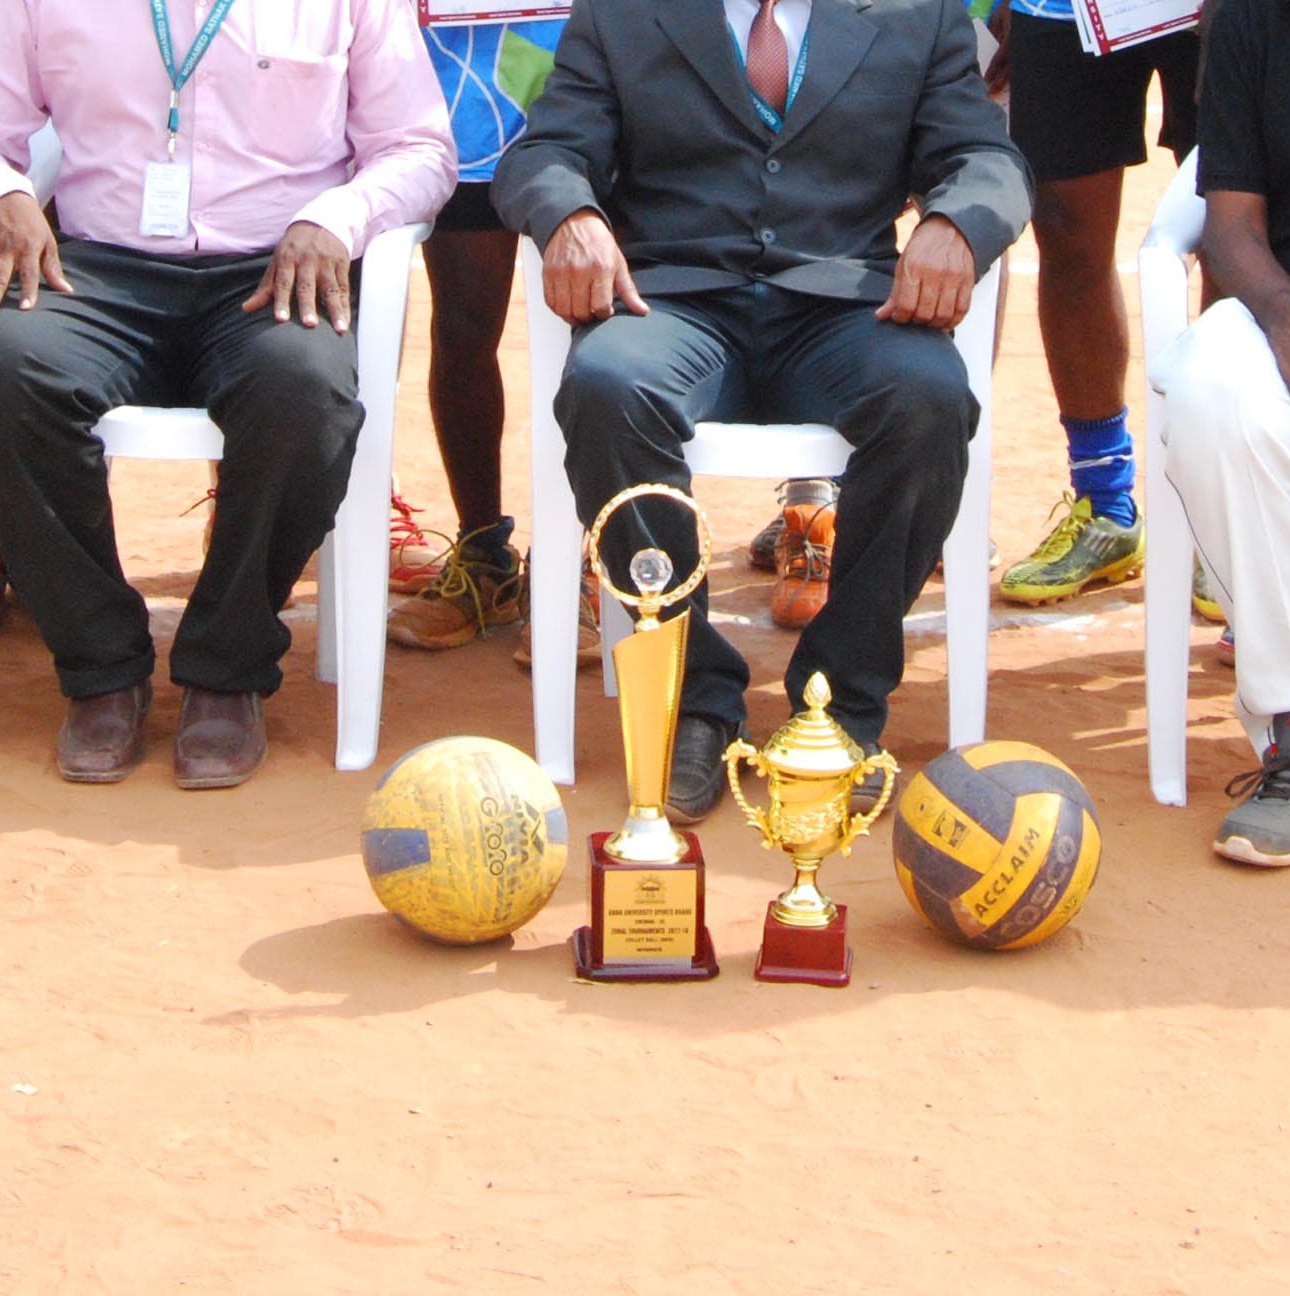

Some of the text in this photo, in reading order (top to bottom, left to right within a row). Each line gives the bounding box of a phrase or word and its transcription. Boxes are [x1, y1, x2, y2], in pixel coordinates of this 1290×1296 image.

[180, 33, 209, 77] MOHAMED
[203, 1, 227, 34] SATHAK
[974, 827, 1040, 918] ACCLAIM
[1000, 834, 1076, 937] COSCO
